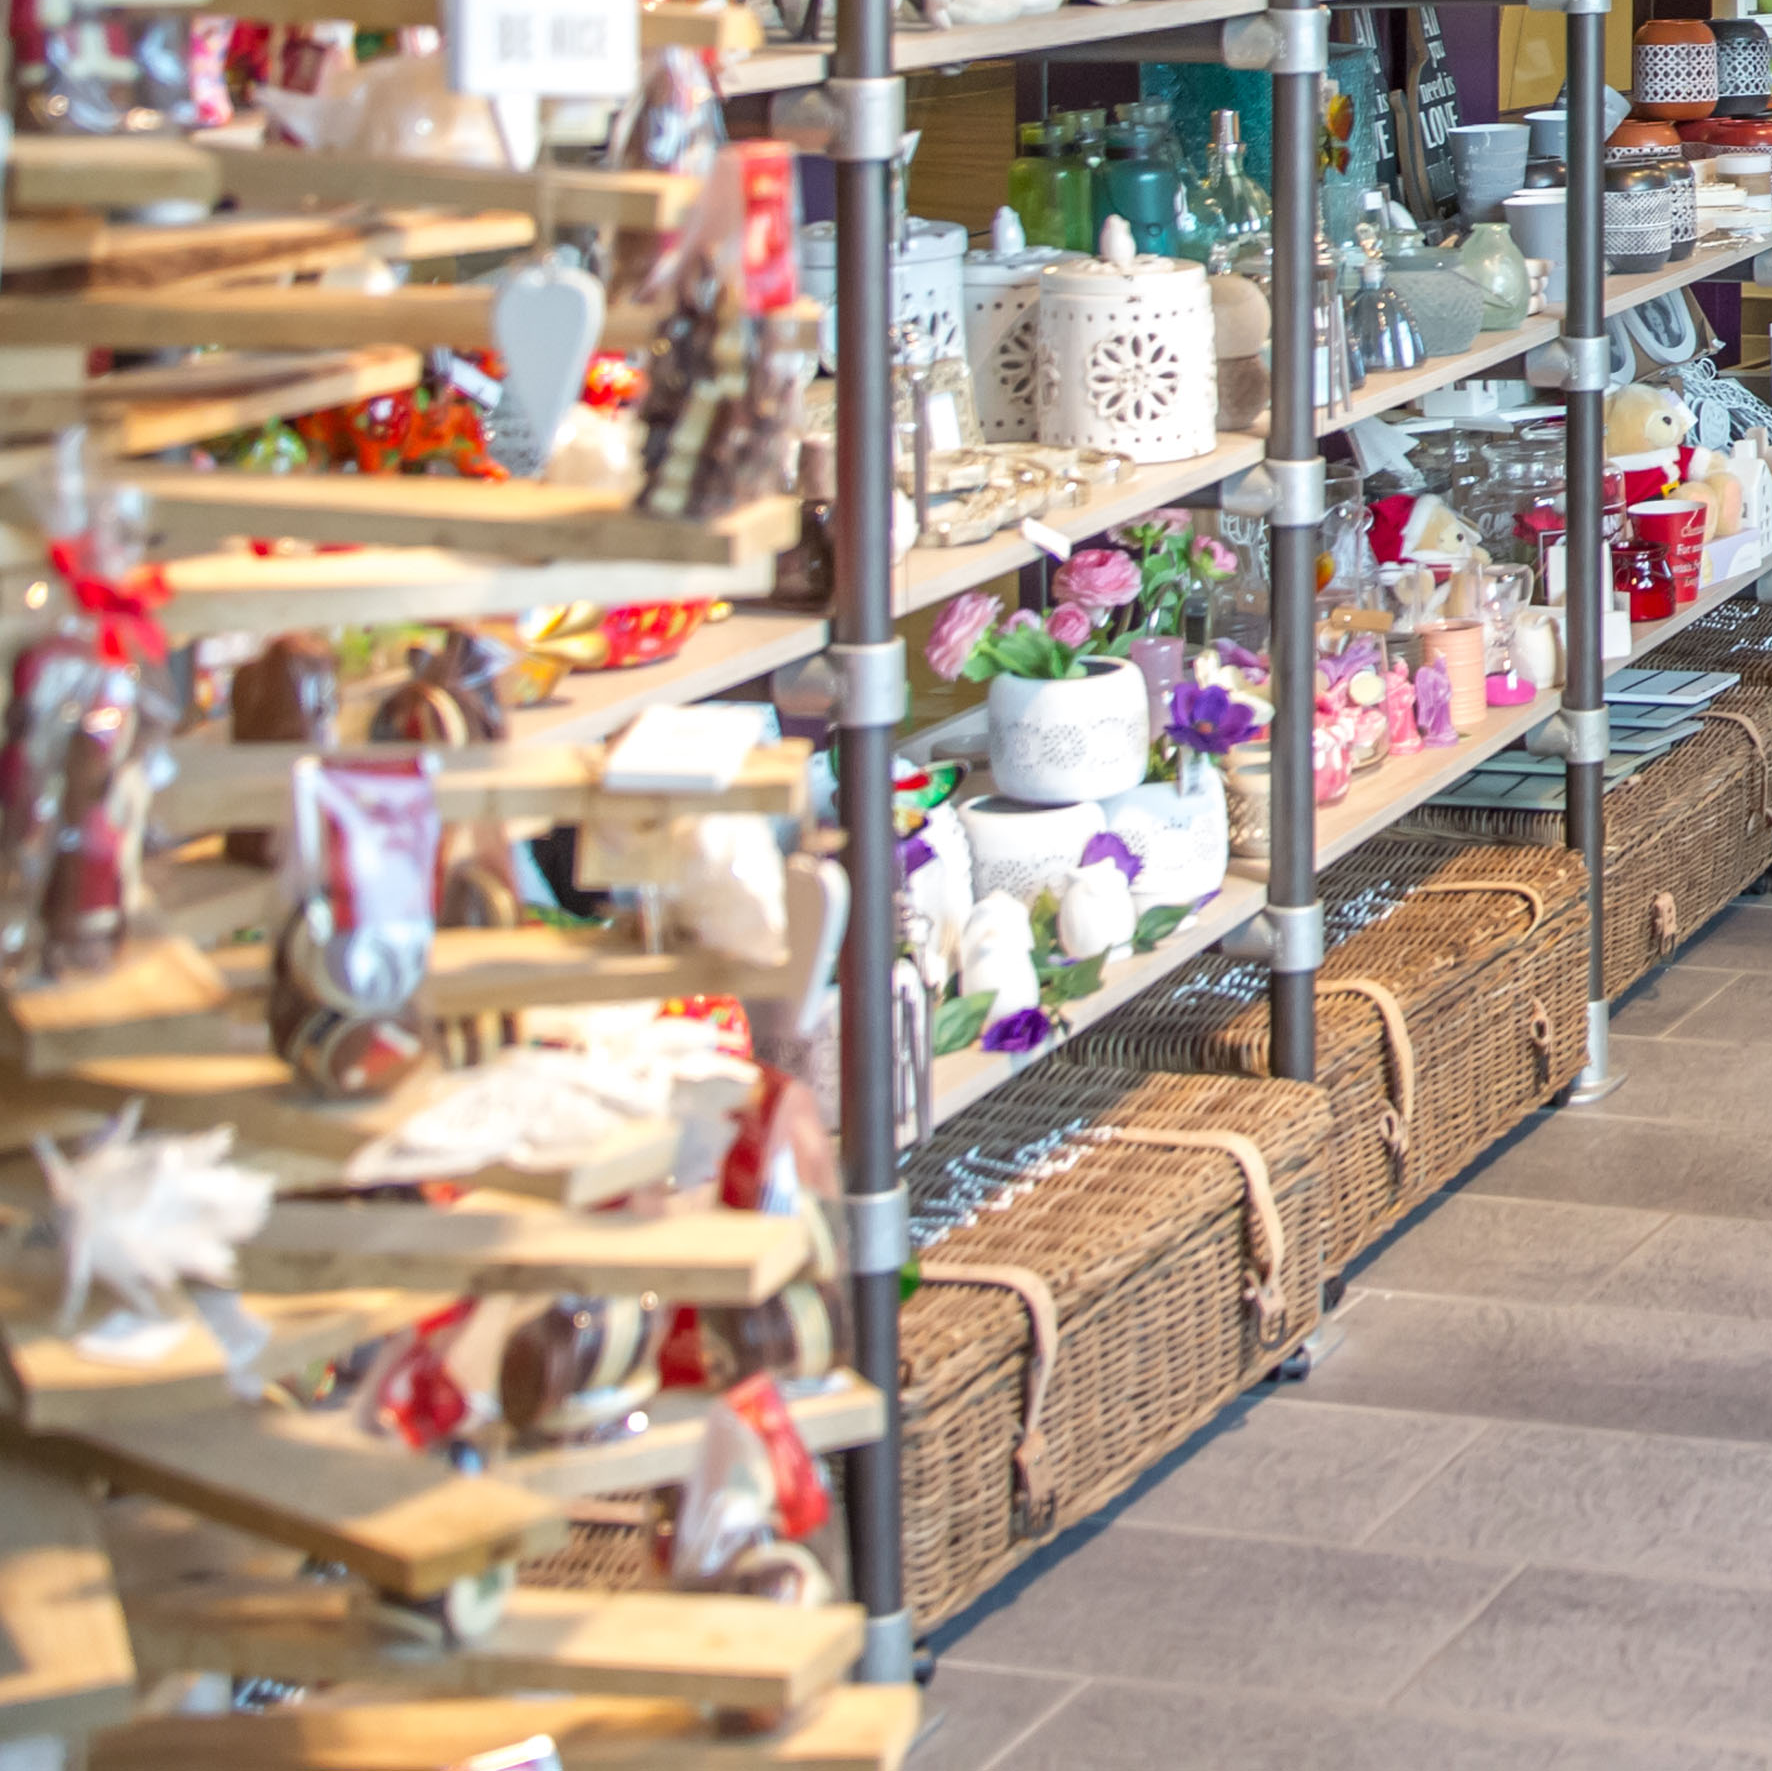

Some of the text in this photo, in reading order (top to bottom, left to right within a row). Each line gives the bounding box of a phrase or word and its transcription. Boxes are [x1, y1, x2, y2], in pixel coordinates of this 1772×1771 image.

[498, 13, 535, 62] BE
[1427, 39, 1447, 69] you
[1420, 71, 1456, 105] need is
[1420, 100, 1459, 149] LOVE
